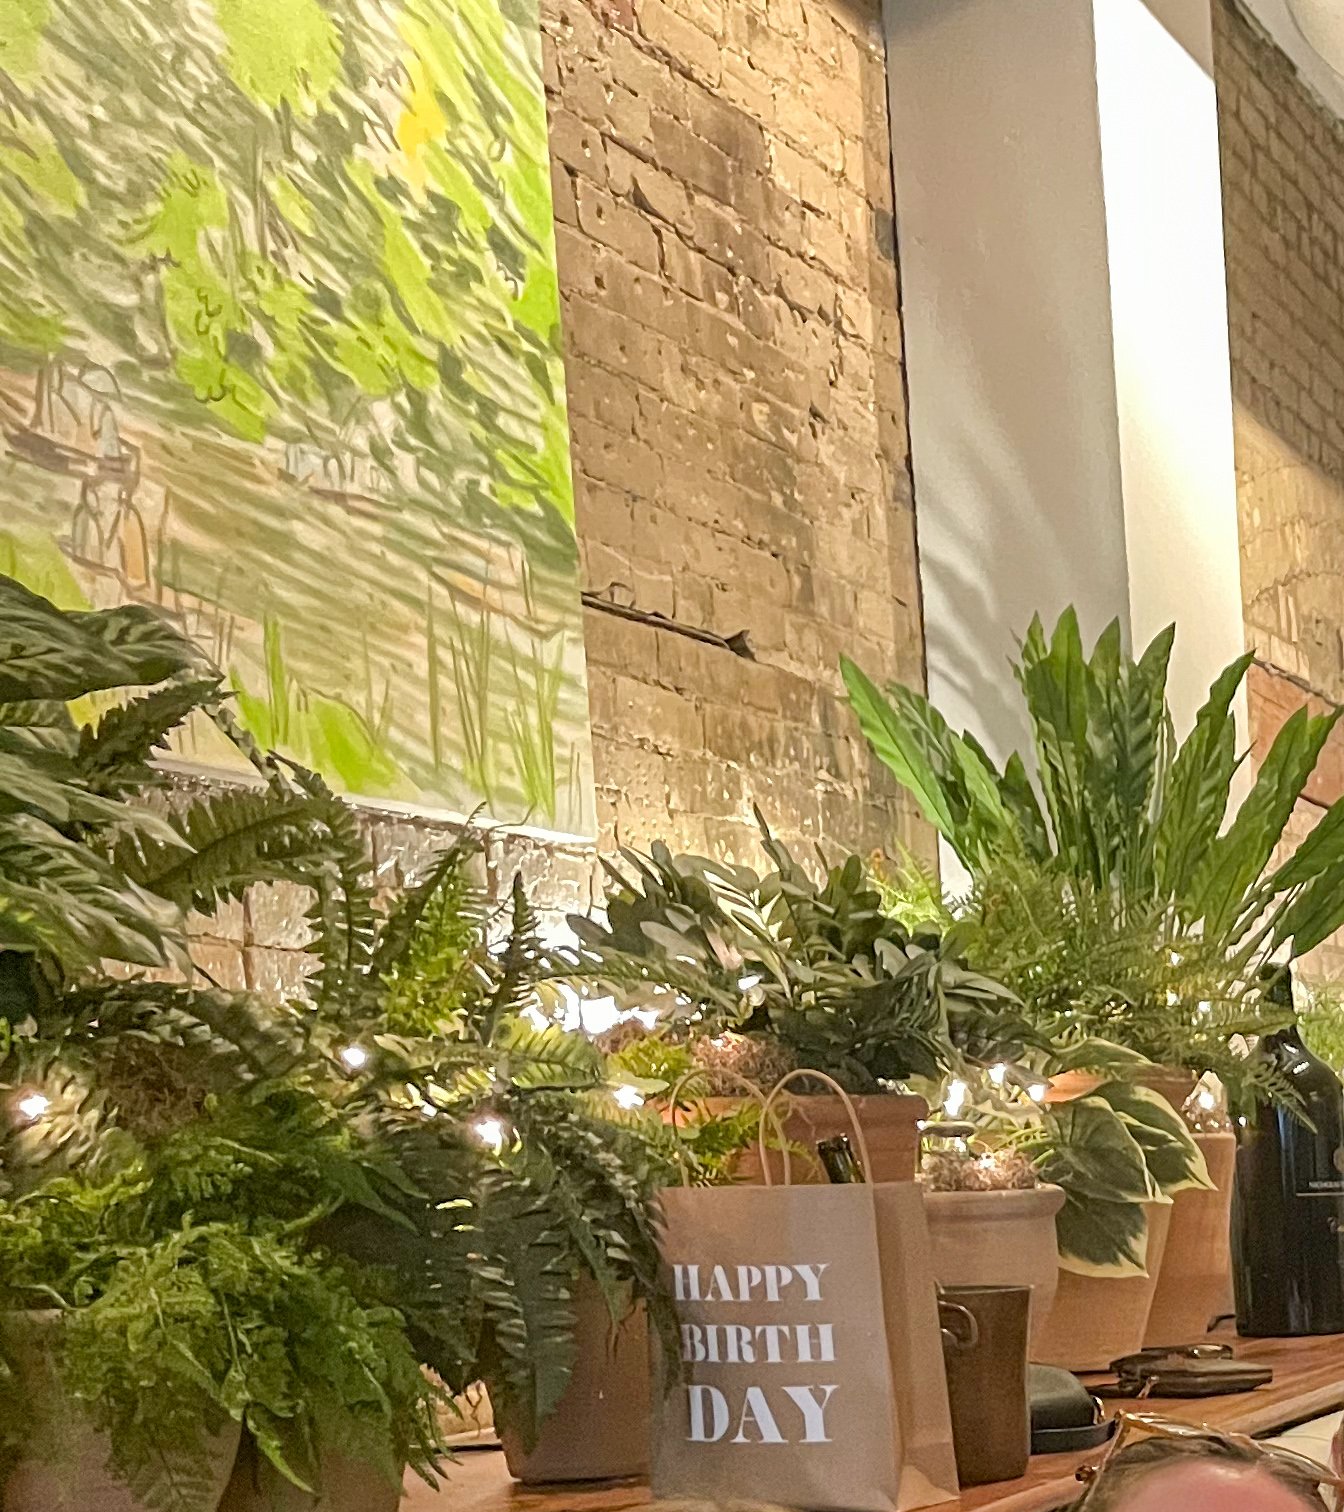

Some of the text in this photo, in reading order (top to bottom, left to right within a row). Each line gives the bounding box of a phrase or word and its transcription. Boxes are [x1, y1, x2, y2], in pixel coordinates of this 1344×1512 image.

[672, 1263, 830, 1302] HAPPY
[680, 1323, 838, 1363] BIRTH
[687, 1384, 840, 1443] DAY
